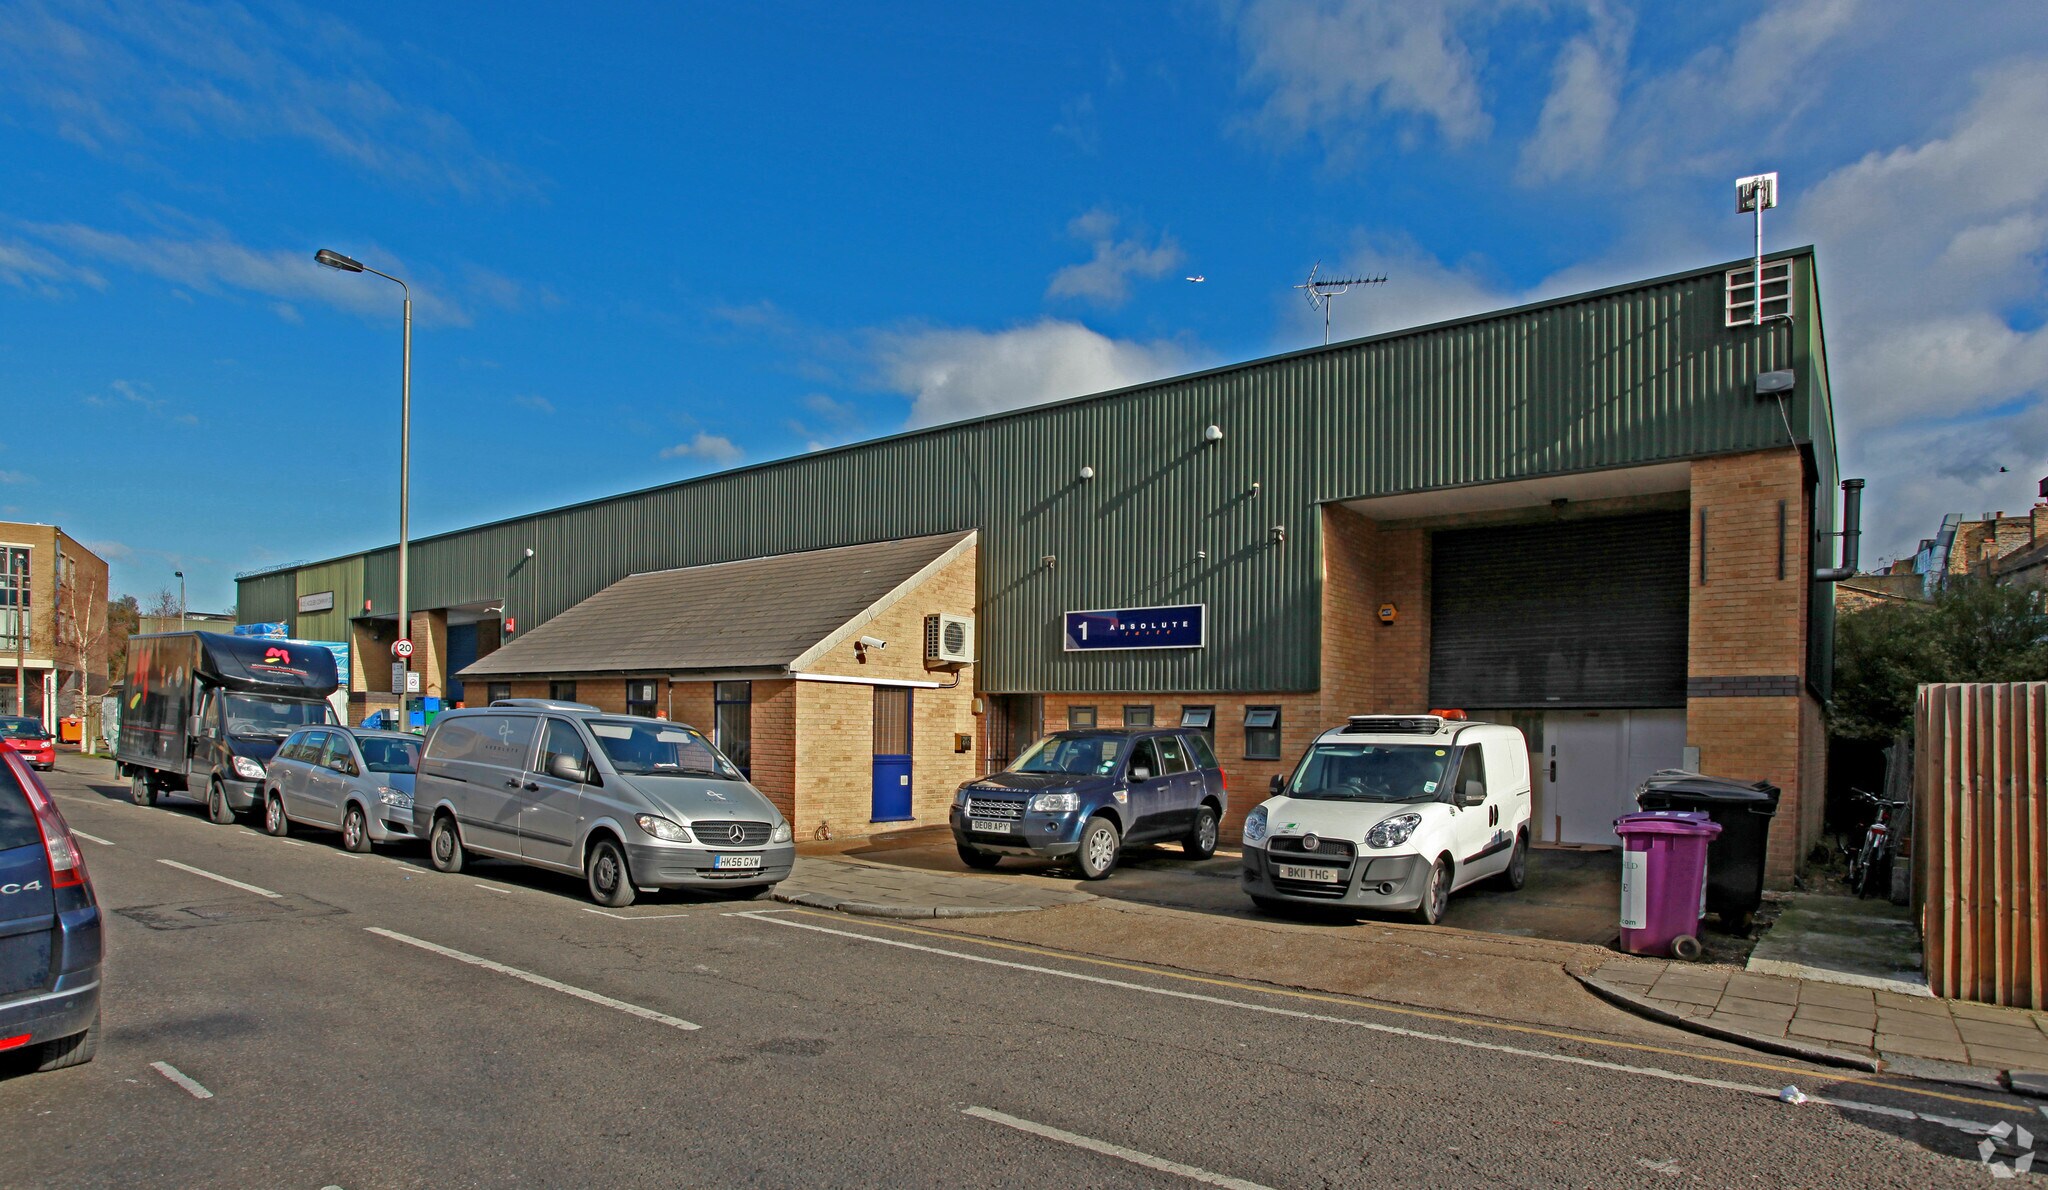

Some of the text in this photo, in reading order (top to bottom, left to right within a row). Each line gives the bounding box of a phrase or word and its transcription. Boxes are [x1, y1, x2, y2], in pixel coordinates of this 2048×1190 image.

[1078, 620, 1189, 641] 1 ABSOLUTE
[1124, 629, 1172, 637] taste
[399, 643, 412, 652] 20
[974, 820, 1009, 831] DE08 APY
[720, 856, 760, 867] HK56 GXW
[1287, 867, 1329, 880] BK11 THG
[0, 879, 43, 895] C4
